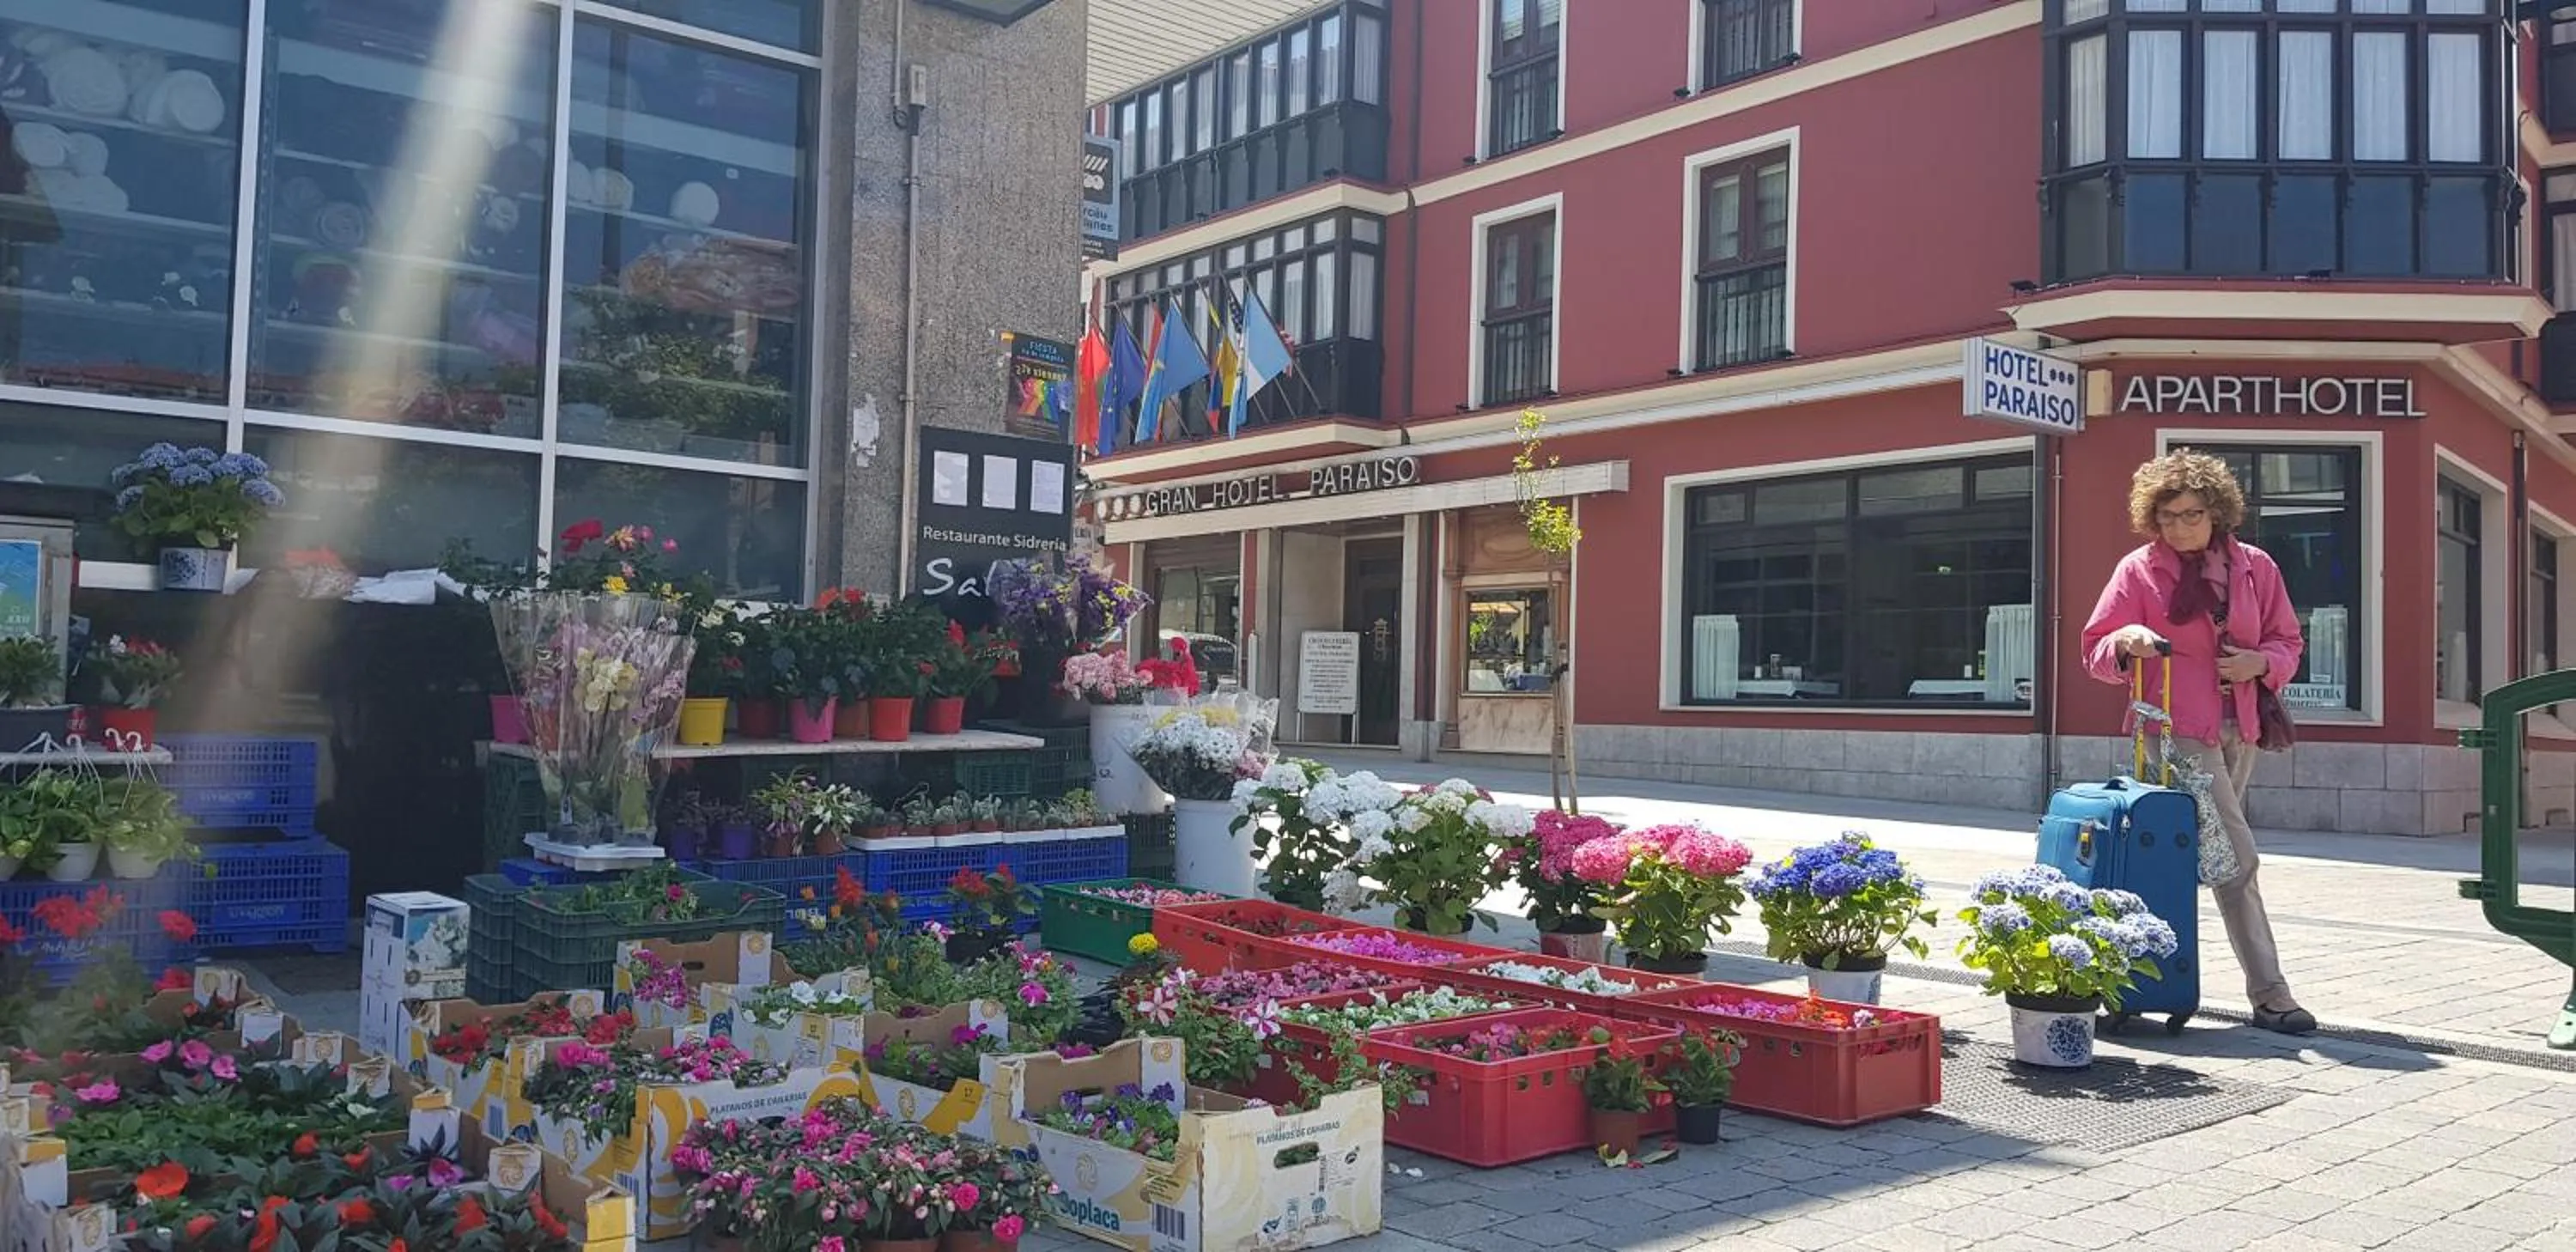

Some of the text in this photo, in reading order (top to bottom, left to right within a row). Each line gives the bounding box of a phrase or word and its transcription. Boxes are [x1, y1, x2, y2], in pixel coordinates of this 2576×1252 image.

[1985, 345, 2049, 386] HOTEL
[1984, 380, 2075, 426] PARAISO
[2120, 375, 2427, 416] APARTHOTEL
[1146, 456, 1416, 514] GRAN HOTEL PARAISO
[923, 525, 1067, 552] Restaurante Sidrería
